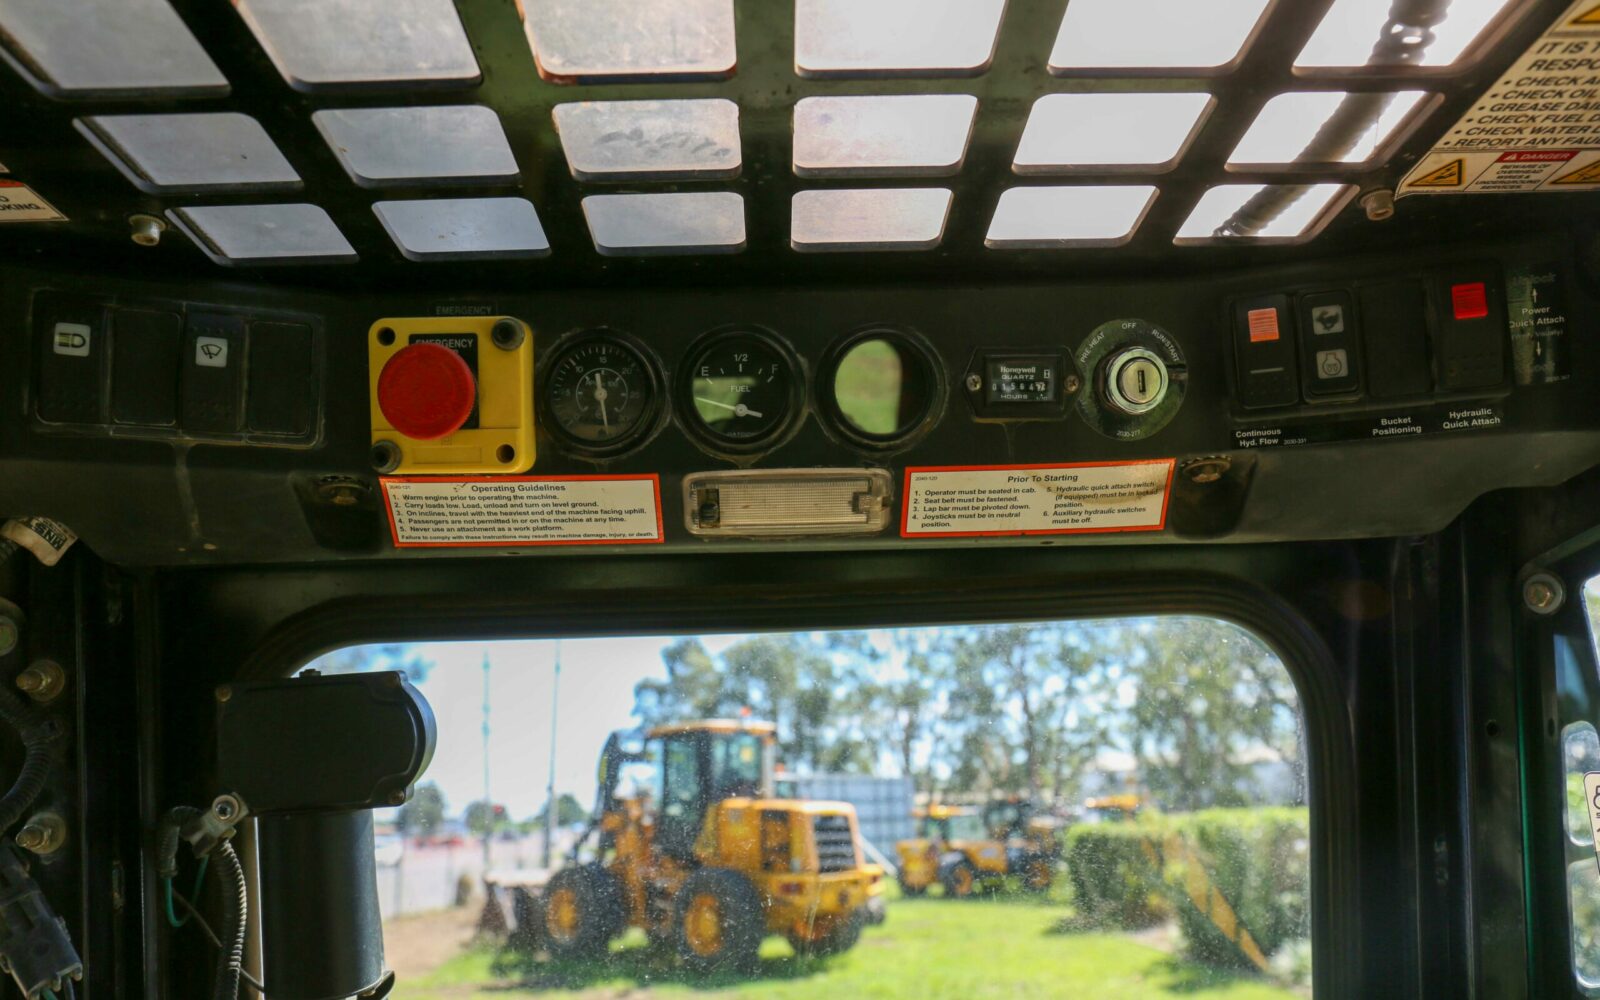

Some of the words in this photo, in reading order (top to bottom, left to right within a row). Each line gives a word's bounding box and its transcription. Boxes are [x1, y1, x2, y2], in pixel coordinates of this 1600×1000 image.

[1536, 41, 1564, 54] IT
[1561, 41, 1588, 54] IS
[1515, 76, 1584, 87] CHECK
[1502, 89, 1570, 100] CHECK
[1569, 88, 1599, 99] OIL
[1489, 102, 1564, 112] GREASE
[1477, 114, 1541, 124] CHECK
[1540, 113, 1585, 123] FUEL
[1465, 126, 1528, 136] CHECK
[1529, 125, 1592, 135] WATER
[1454, 138, 1523, 147] REPORT
[1522, 137, 1565, 146] ANY
[436, 306, 492, 315] EMERGENCY
[1522, 306, 1551, 316] Power
[1537, 315, 1565, 326] Attach
[1121, 322, 1137, 330] OFF
[415, 339, 474, 349] RGENCY
[1080, 331, 1105, 363] PRE-HEAT
[1152, 329, 1180, 362] RUN/START
[734, 353, 748, 362] 1/2
[701, 366, 710, 377] E
[771, 364, 778, 374] F
[1000, 366, 1036, 374] Honeywell
[1449, 408, 1492, 420] Hydraulic
[1381, 416, 1412, 426] Bucket
[1443, 420, 1469, 430] Quick
[1471, 416, 1500, 428] Attach
[1235, 428, 1282, 438] Continuous
[1372, 425, 1422, 436] Positioning
[1240, 439, 1258, 448] Hyd.
[471, 485, 515, 493] Operating
